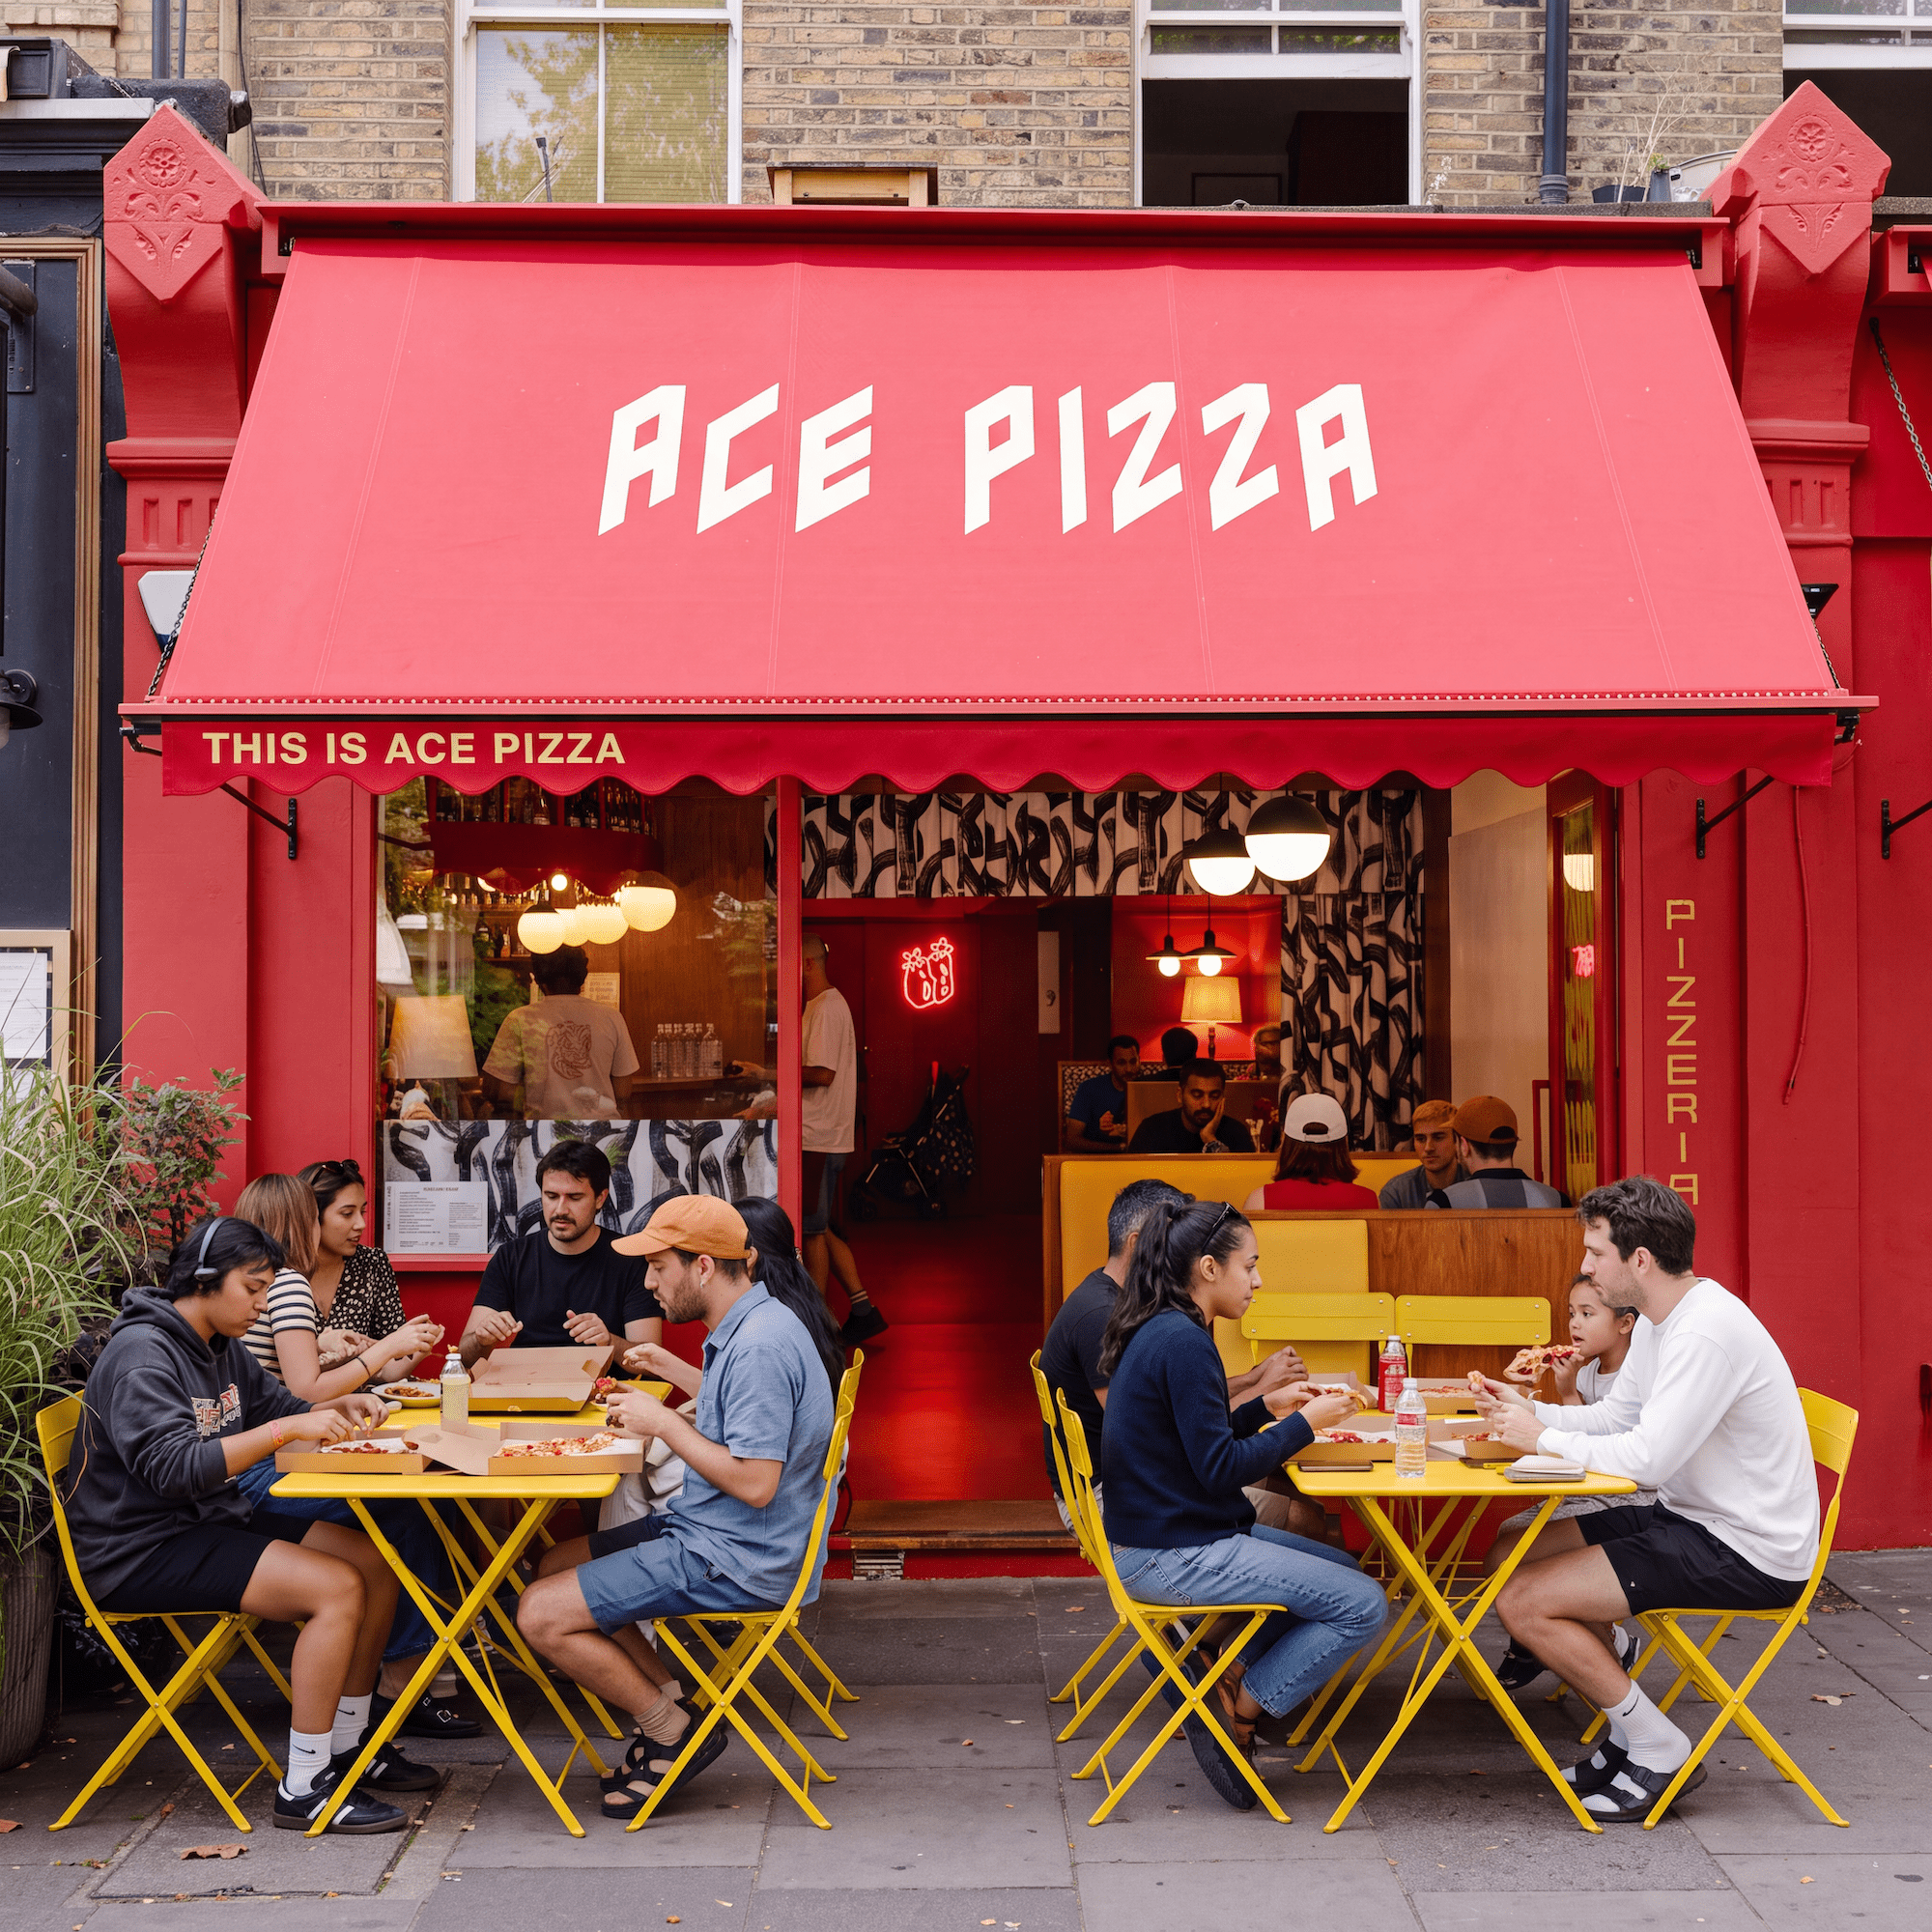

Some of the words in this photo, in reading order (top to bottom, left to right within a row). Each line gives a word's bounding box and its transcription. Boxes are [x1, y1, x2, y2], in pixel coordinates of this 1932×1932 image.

[598, 383, 873, 536] ACE
[964, 382, 1378, 535] PIZZA
[202, 731, 308, 765] THIS
[327, 731, 367, 765] IS
[384, 731, 475, 765] ACE
[494, 731, 626, 765] PIZZA
[1665, 899, 1699, 1206] PIZZERIA
